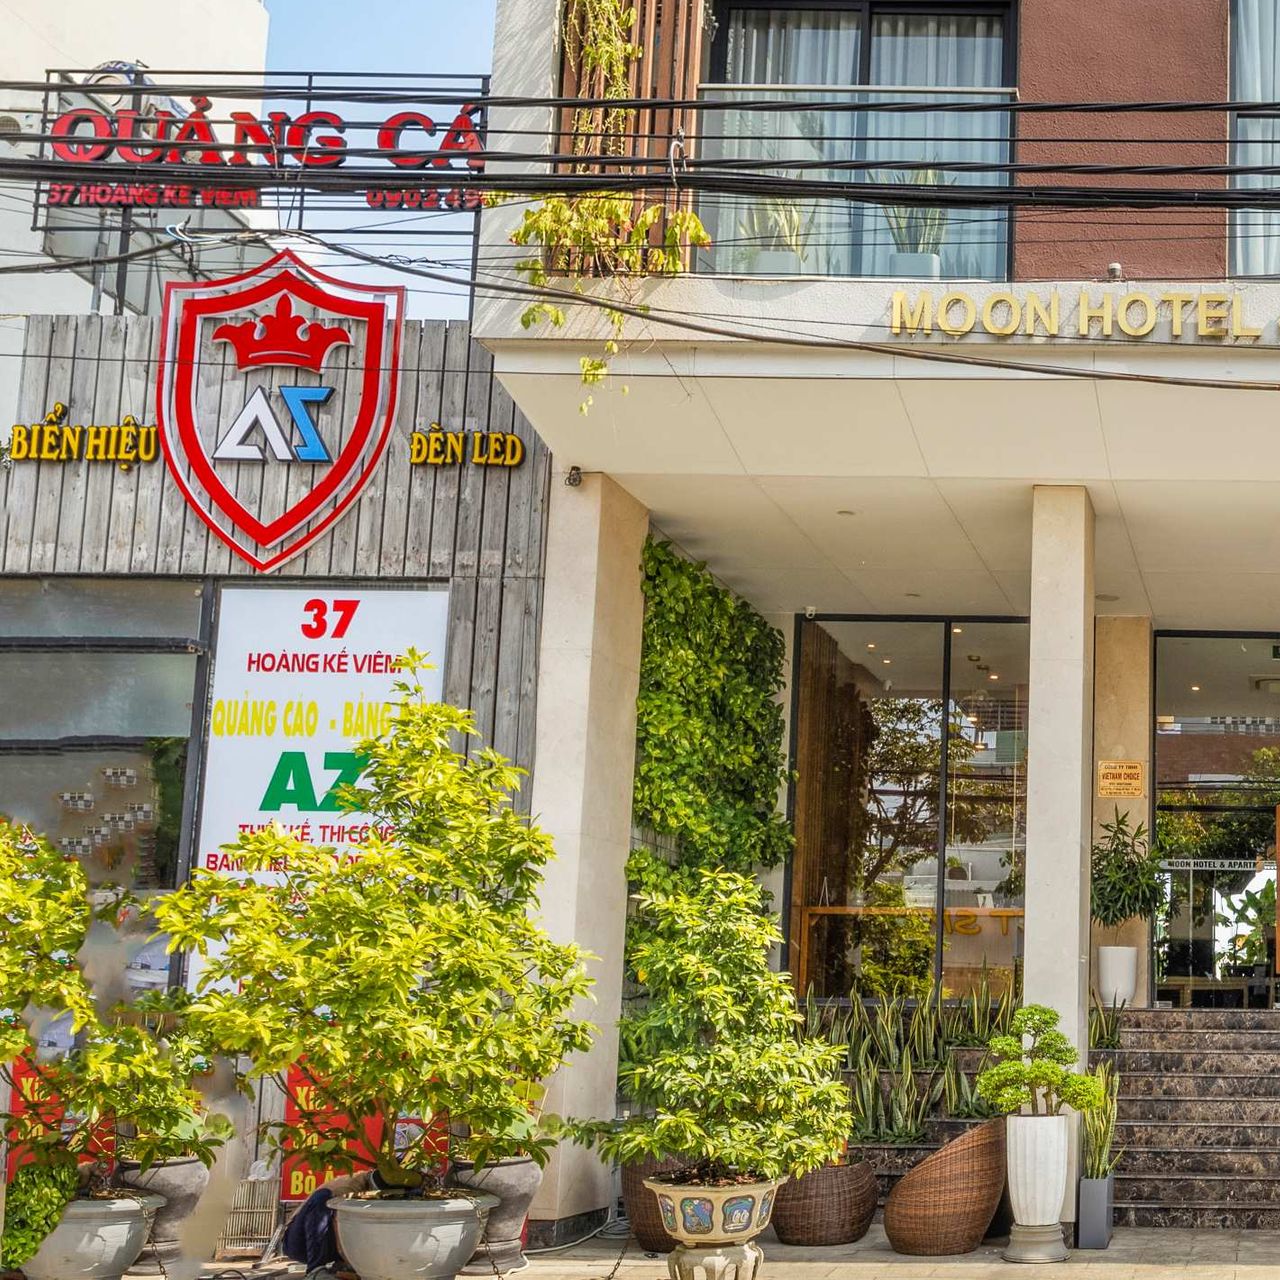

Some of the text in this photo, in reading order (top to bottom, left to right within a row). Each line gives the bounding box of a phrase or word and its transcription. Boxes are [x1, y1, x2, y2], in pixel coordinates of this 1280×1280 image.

[51, 96, 348, 168] QUẢNG
[48, 183, 74, 205] 37
[890, 288, 1061, 338] MOON
[1078, 290, 1262, 339] HOTEL
[11, 401, 159, 472] BIỂN HIỆU
[410, 421, 526, 467] ĐÈN LED
[301, 598, 361, 639] 37
[247, 649, 320, 673] HOÀNG
[322, 646, 349, 673] KẾ
[212, 690, 278, 737] QUẢNG
[258, 751, 374, 812] AZ
[1193, 861, 1217, 870] HOTEL
